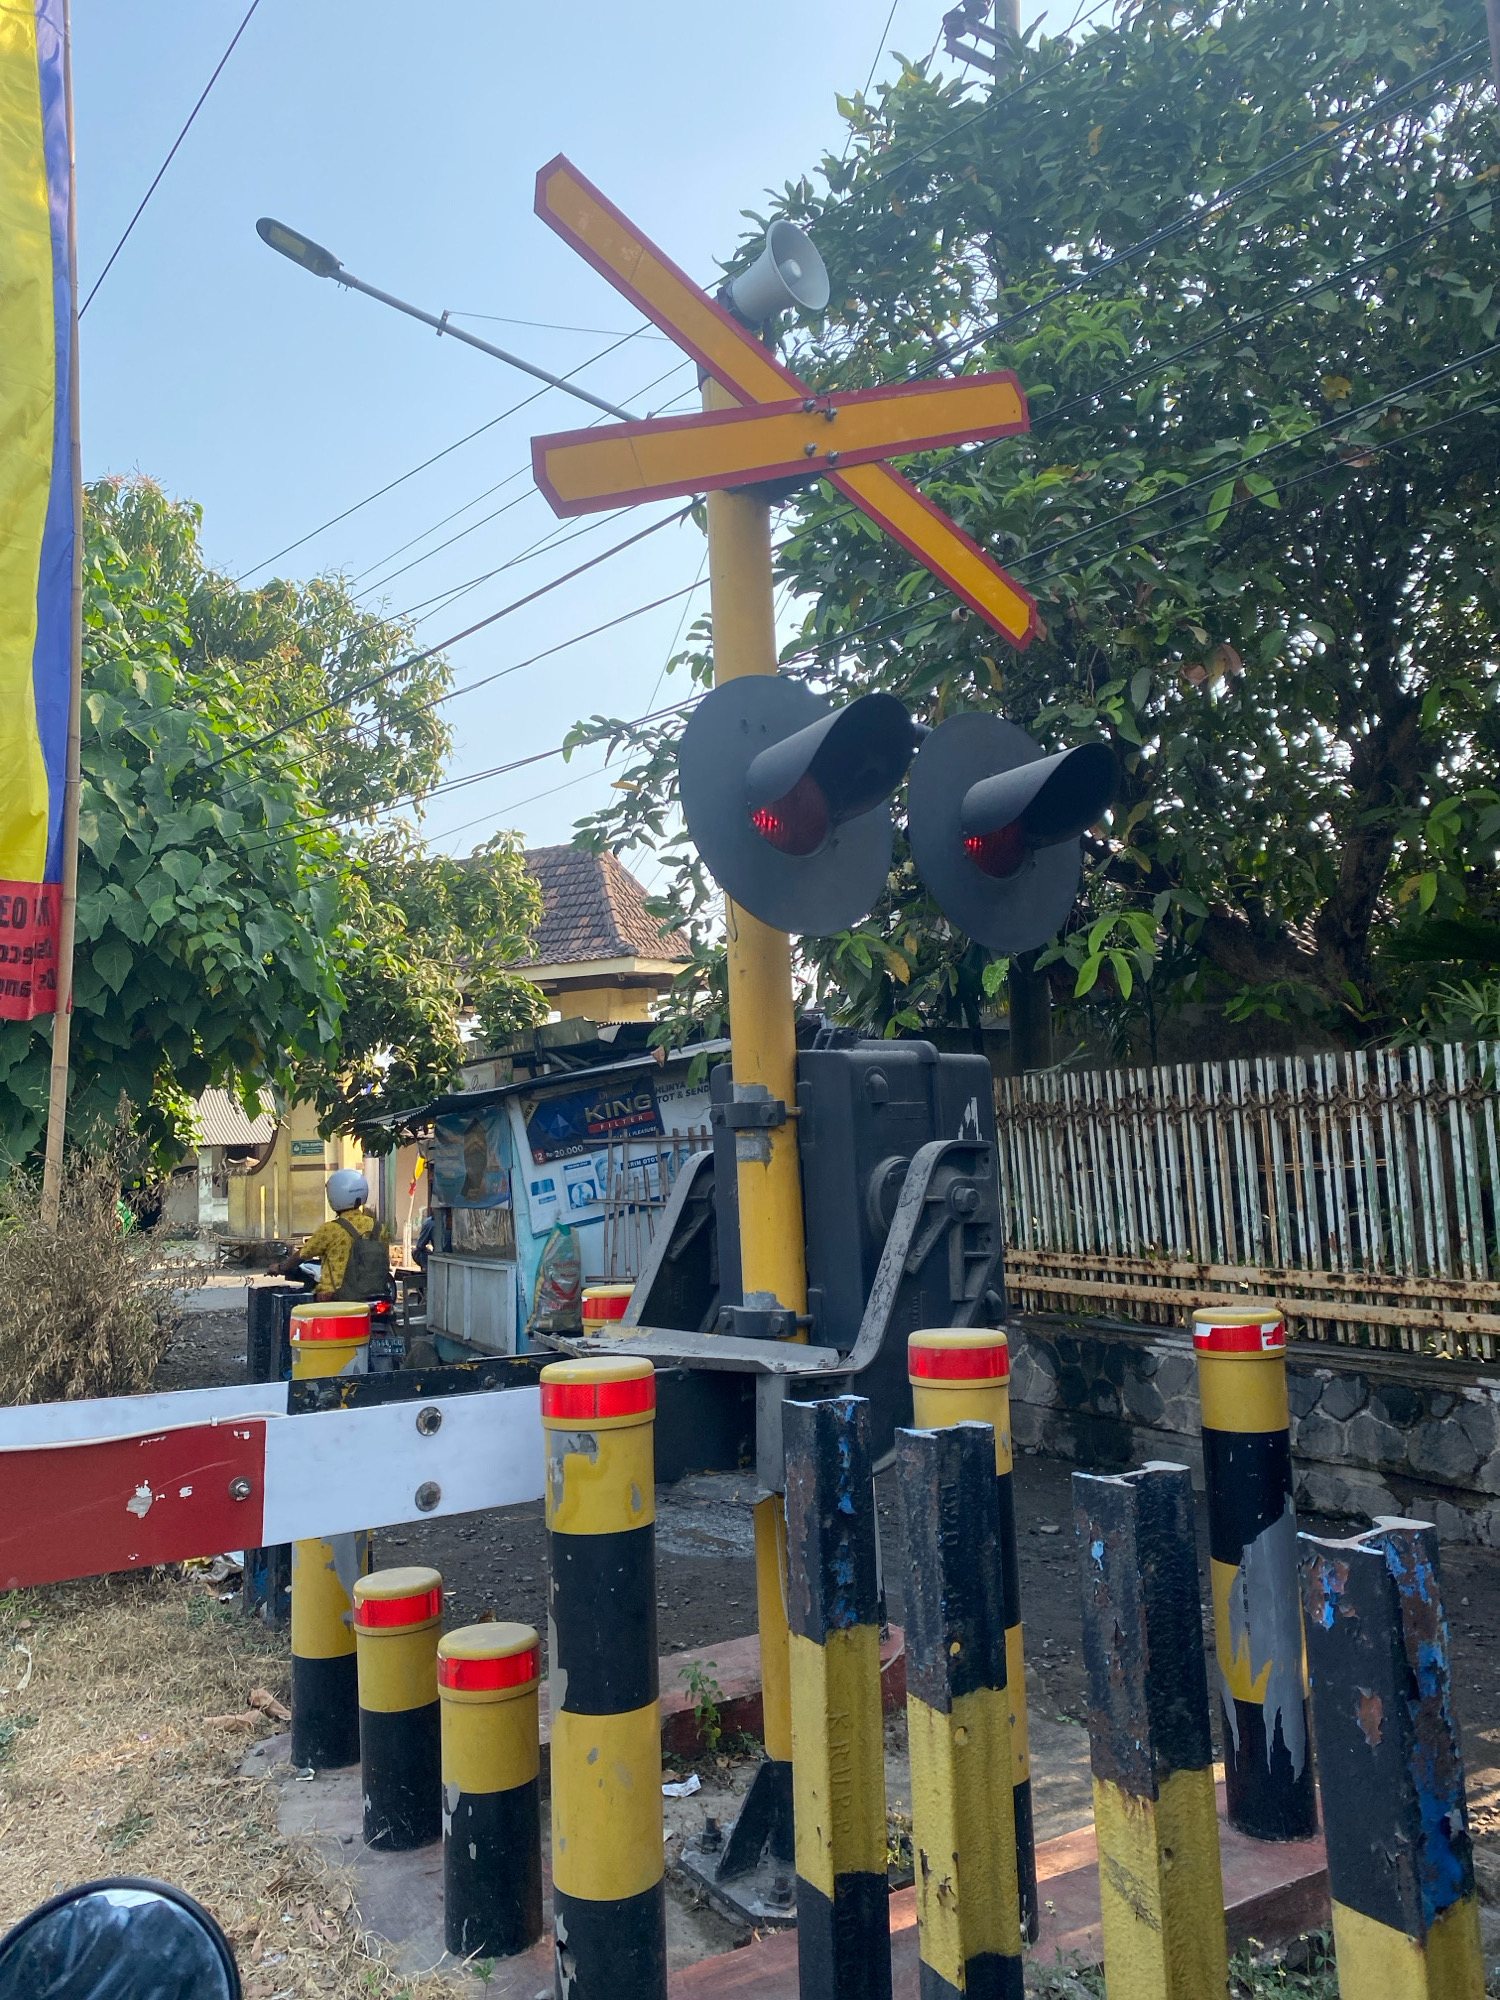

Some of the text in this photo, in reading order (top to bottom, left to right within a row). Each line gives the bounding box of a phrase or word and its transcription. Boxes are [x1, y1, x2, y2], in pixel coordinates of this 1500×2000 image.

[523, 1102, 535, 1120] NEW
[584, 1094, 653, 1122] KING
[600, 1115, 643, 1130] FILTER
[554, 1144, 584, 1159] 20.000
[829, 1711, 853, 1836] KRUPP
